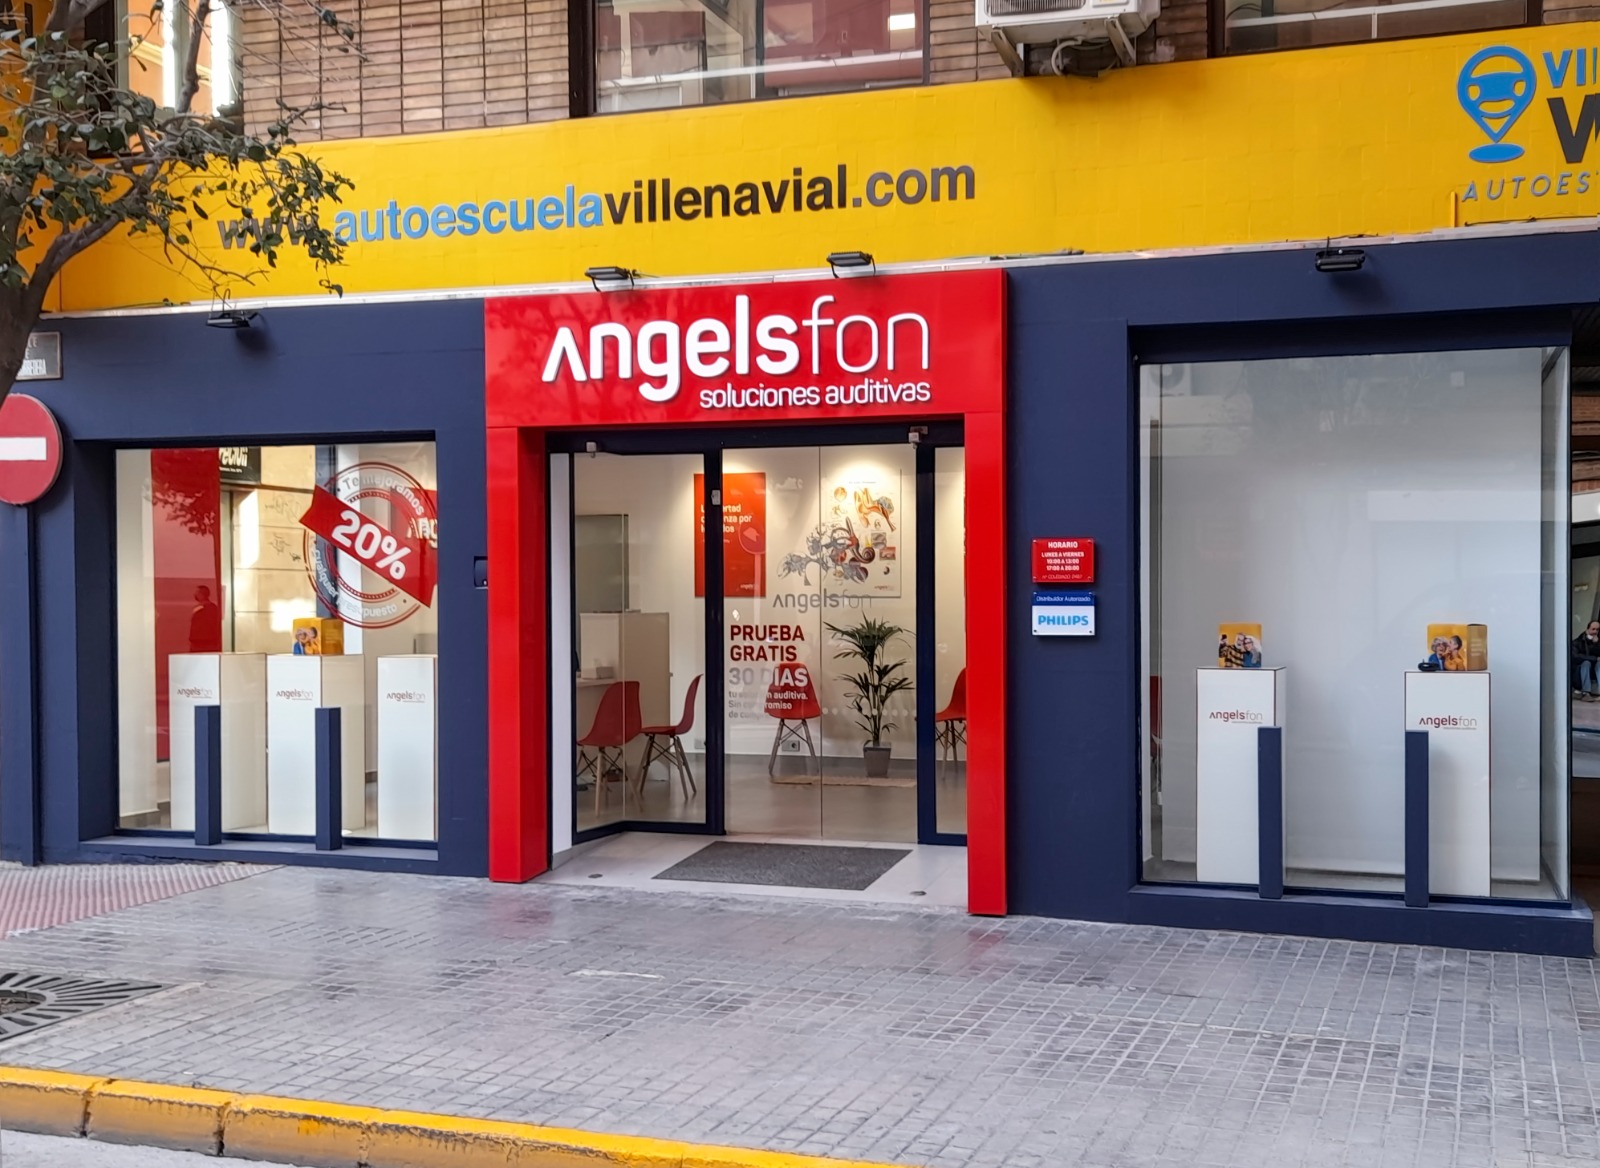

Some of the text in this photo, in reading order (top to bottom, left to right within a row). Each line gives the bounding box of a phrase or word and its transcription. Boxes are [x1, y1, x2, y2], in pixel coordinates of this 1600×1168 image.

[1462, 170, 1600, 202] AUTOES
[700, 377, 931, 409] soluciones auditivas
[342, 474, 425, 516] Te mejoramos
[739, 514, 753, 525] por
[331, 509, 411, 580] 20%
[1048, 541, 1078, 549] HORARIO
[1037, 615, 1089, 626] PHILIPS
[730, 624, 805, 642] PRUEBA
[730, 645, 798, 662] GRATIS
[728, 667, 754, 686] 30
[773, 690, 809, 700] auditiva.
